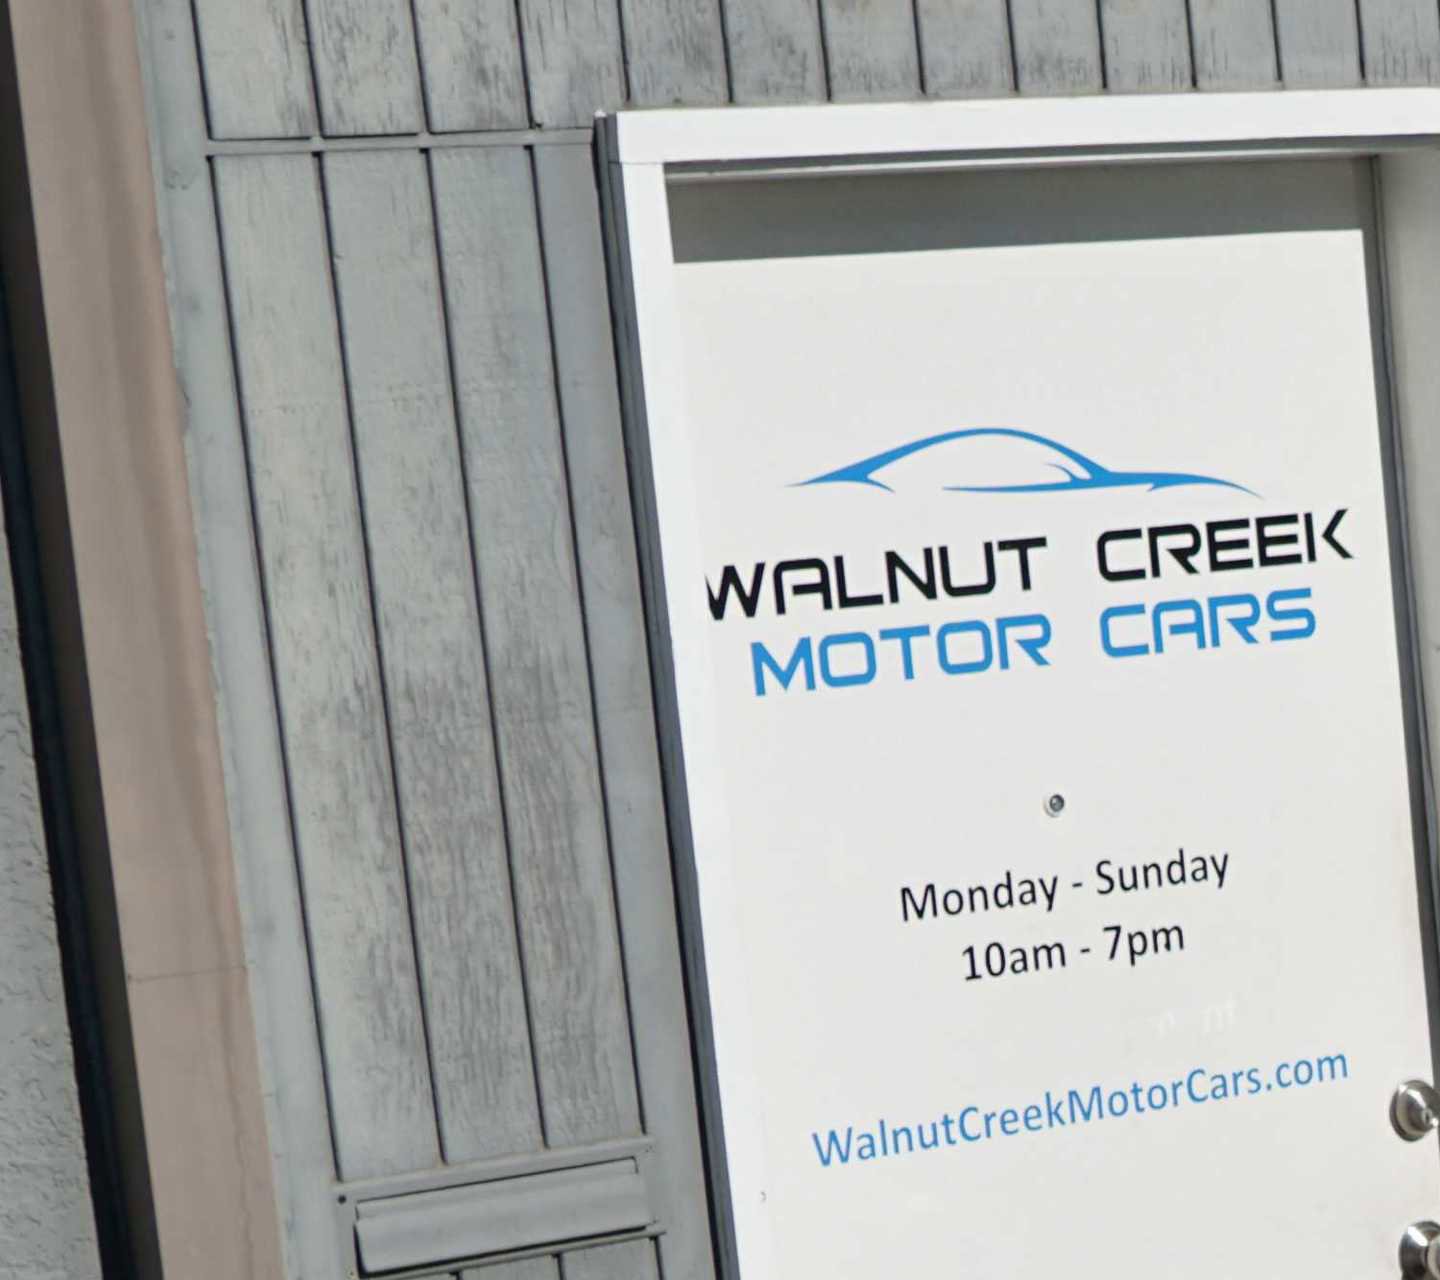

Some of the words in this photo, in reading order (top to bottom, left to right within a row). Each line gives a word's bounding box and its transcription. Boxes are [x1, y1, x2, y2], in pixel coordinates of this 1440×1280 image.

[706, 536, 1049, 621] WALNUT
[1097, 508, 1354, 582] CREEK
[749, 613, 1052, 697] MOTOR
[1099, 587, 1318, 659] CARS
[900, 869, 1059, 922] Monday
[1095, 847, 1230, 897] Sunday
[961, 941, 1067, 982] 10am
[1103, 921, 1186, 969] 7pm
[812, 1052, 1350, 1169] WalnutCreekMotorCars.com
